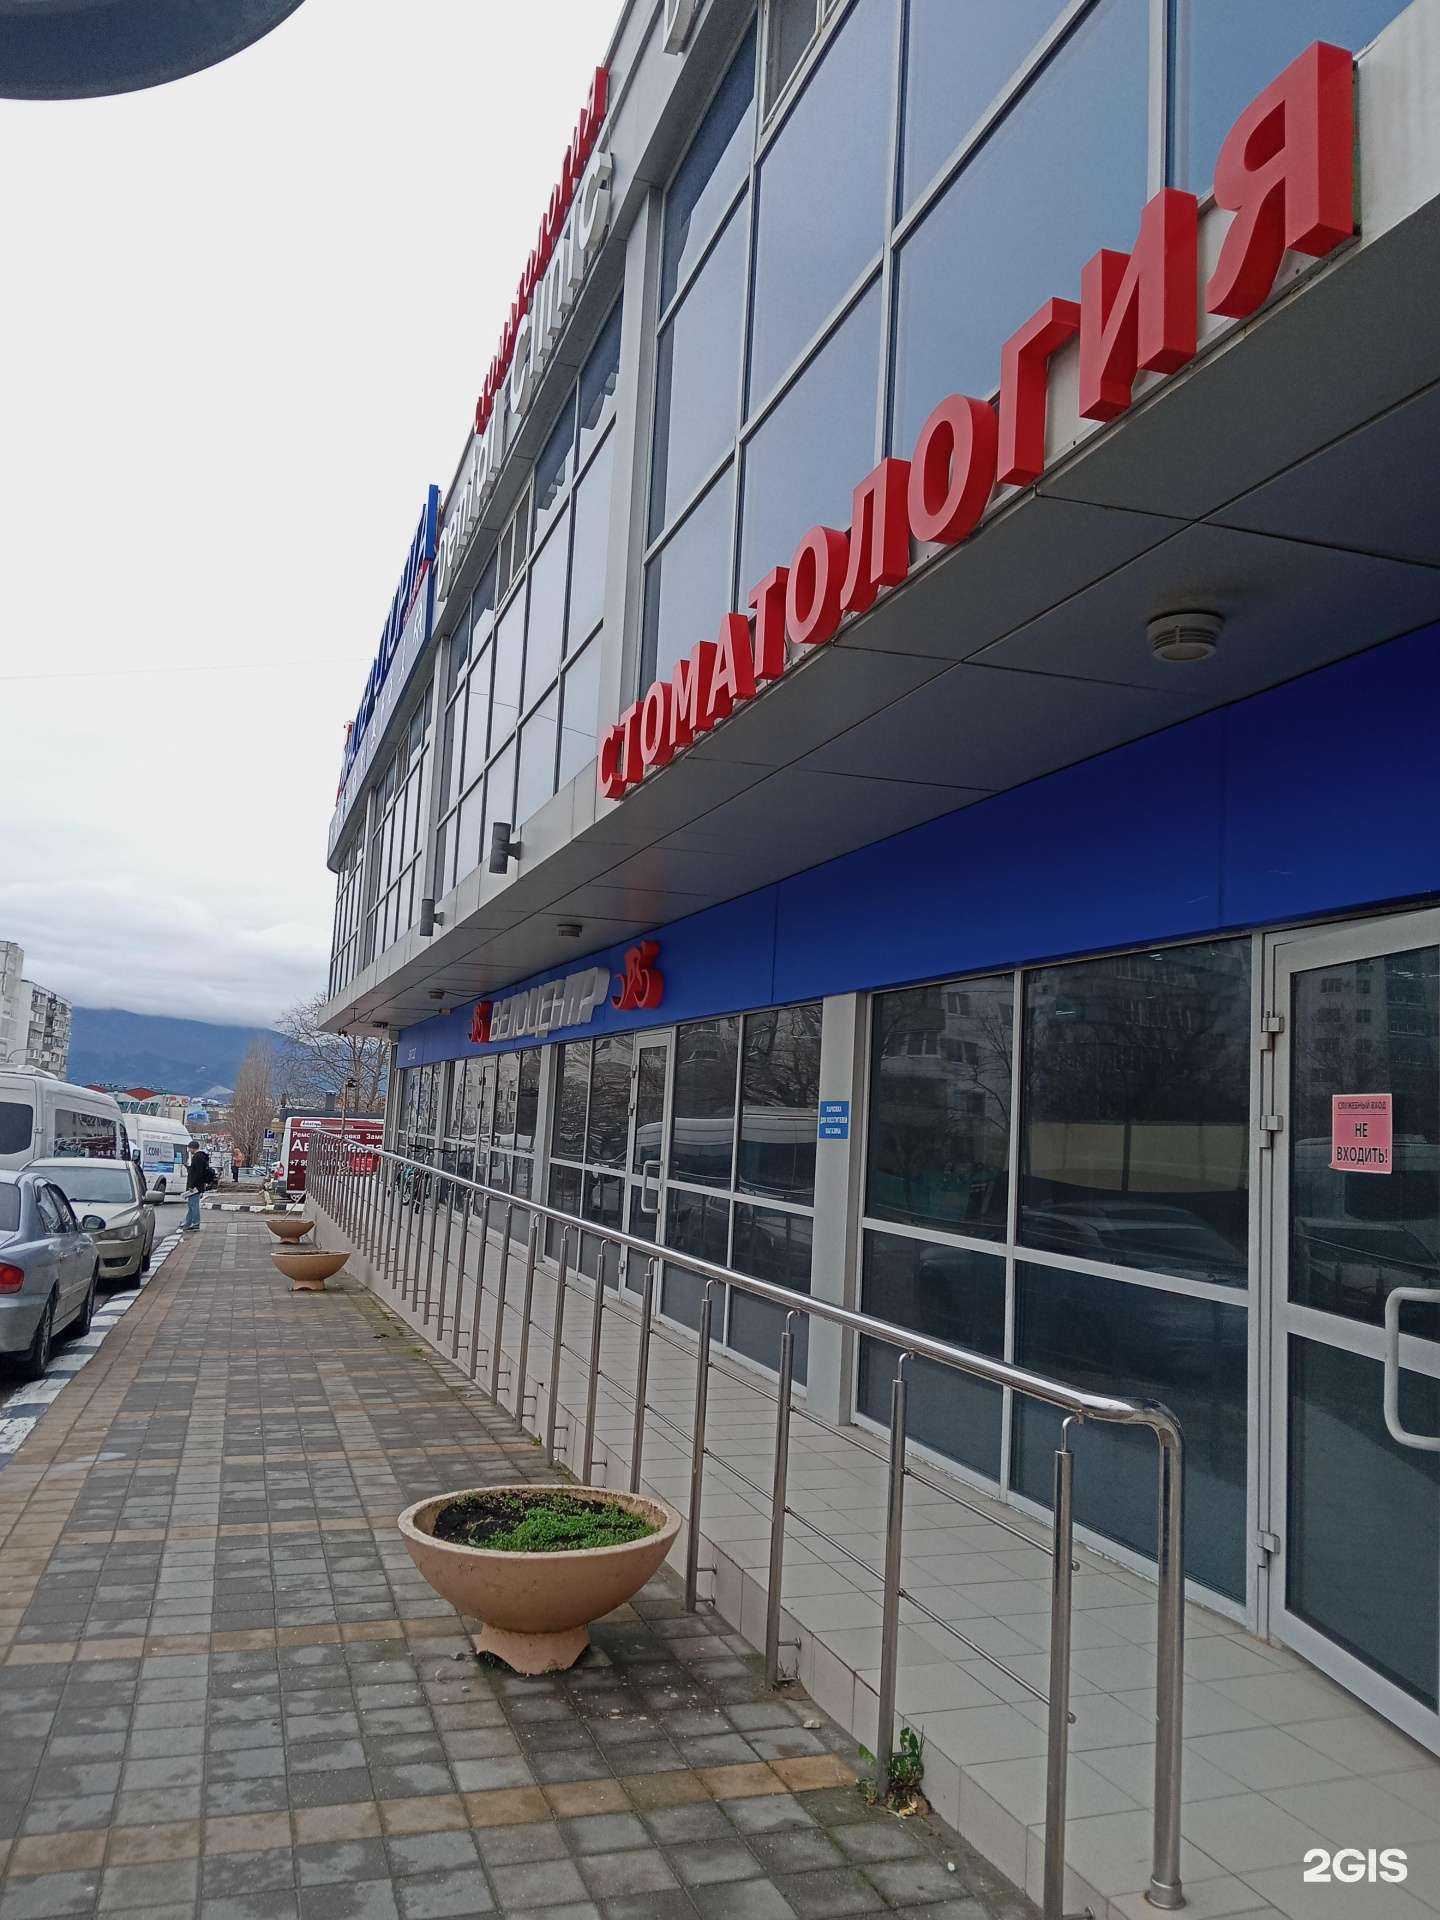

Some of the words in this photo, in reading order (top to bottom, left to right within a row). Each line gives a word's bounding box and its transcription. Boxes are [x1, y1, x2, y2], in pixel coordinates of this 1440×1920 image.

[599, 41, 1356, 800] СТОМАТОЛОГИЯ
[489, 966, 610, 1042] ВЕЛОЦЕНТР
[1354, 1122, 1368, 1138] НЕ
[1336, 1146, 1388, 1165] ВХОДИТЬ!
